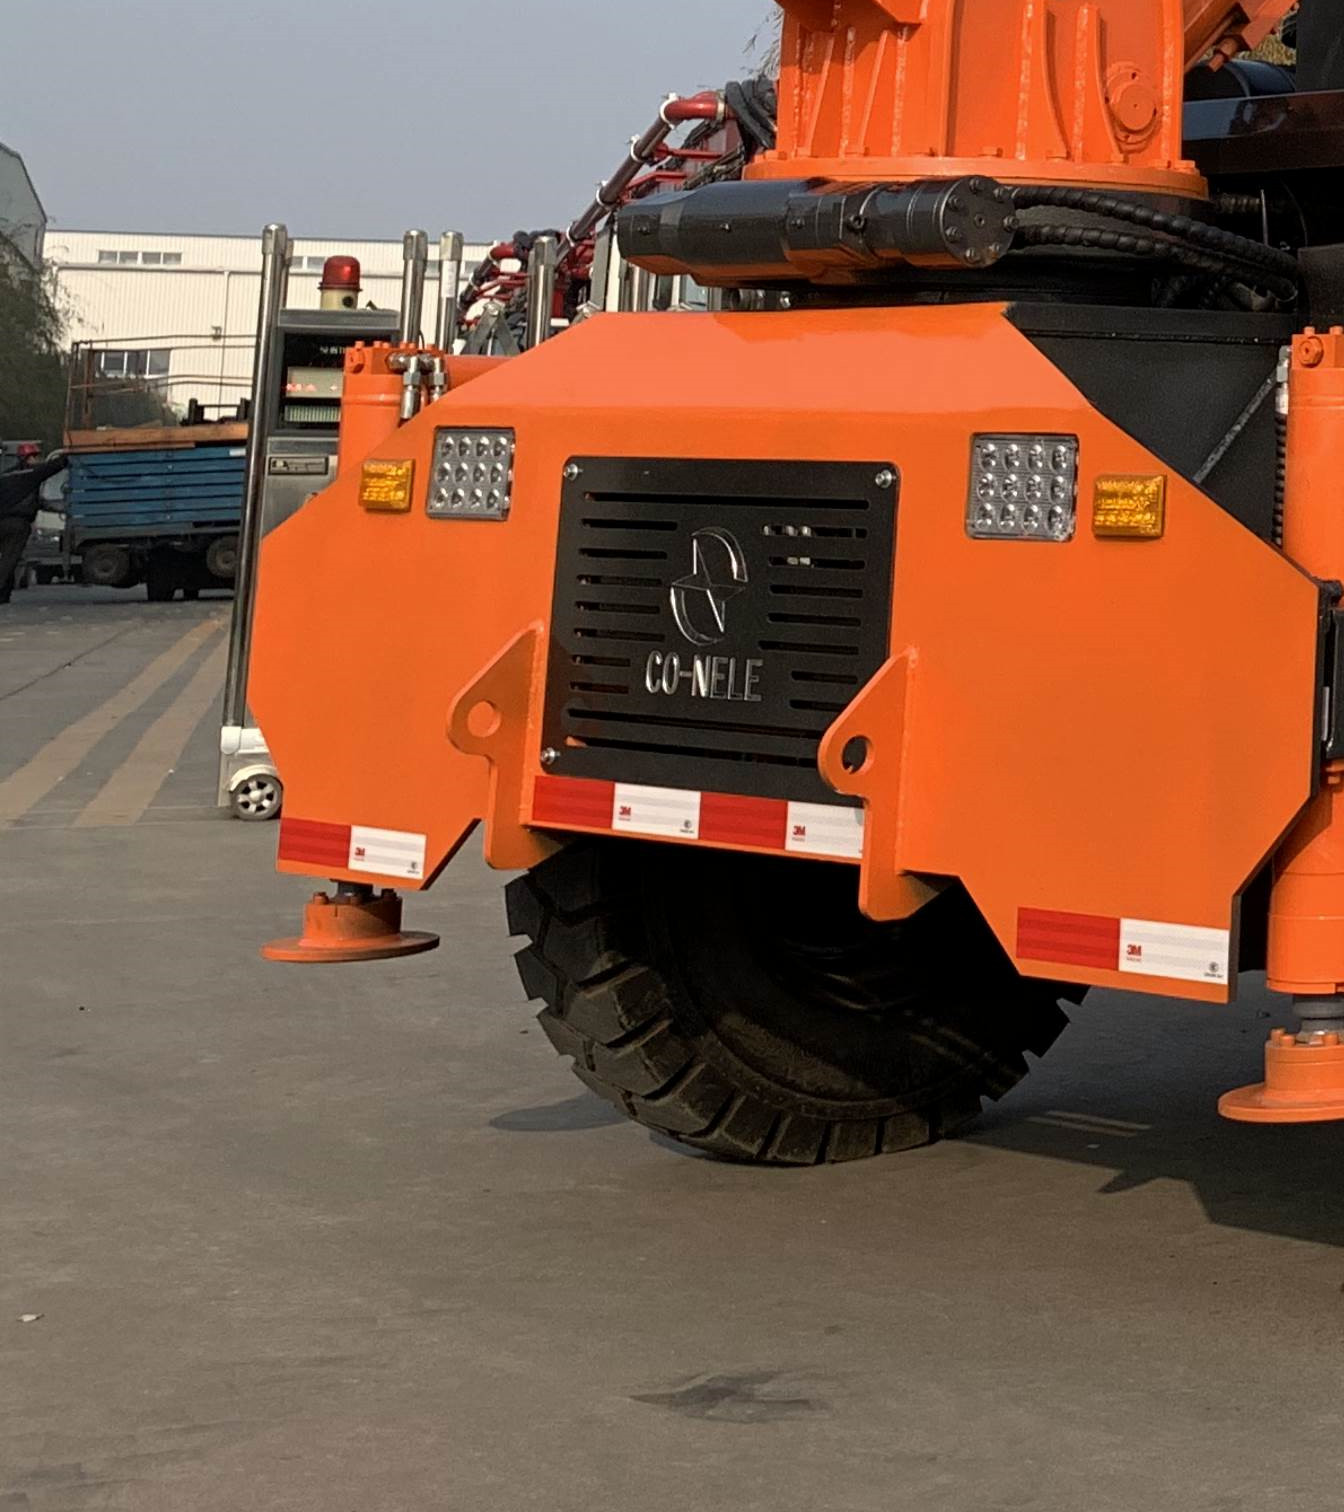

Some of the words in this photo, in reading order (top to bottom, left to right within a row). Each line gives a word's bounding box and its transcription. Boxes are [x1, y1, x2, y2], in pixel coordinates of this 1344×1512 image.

[645, 649, 764, 703] CO-NELE
[618, 805, 632, 817] 3M
[792, 824, 807, 837] 3M
[1126, 943, 1143, 957] 3M
